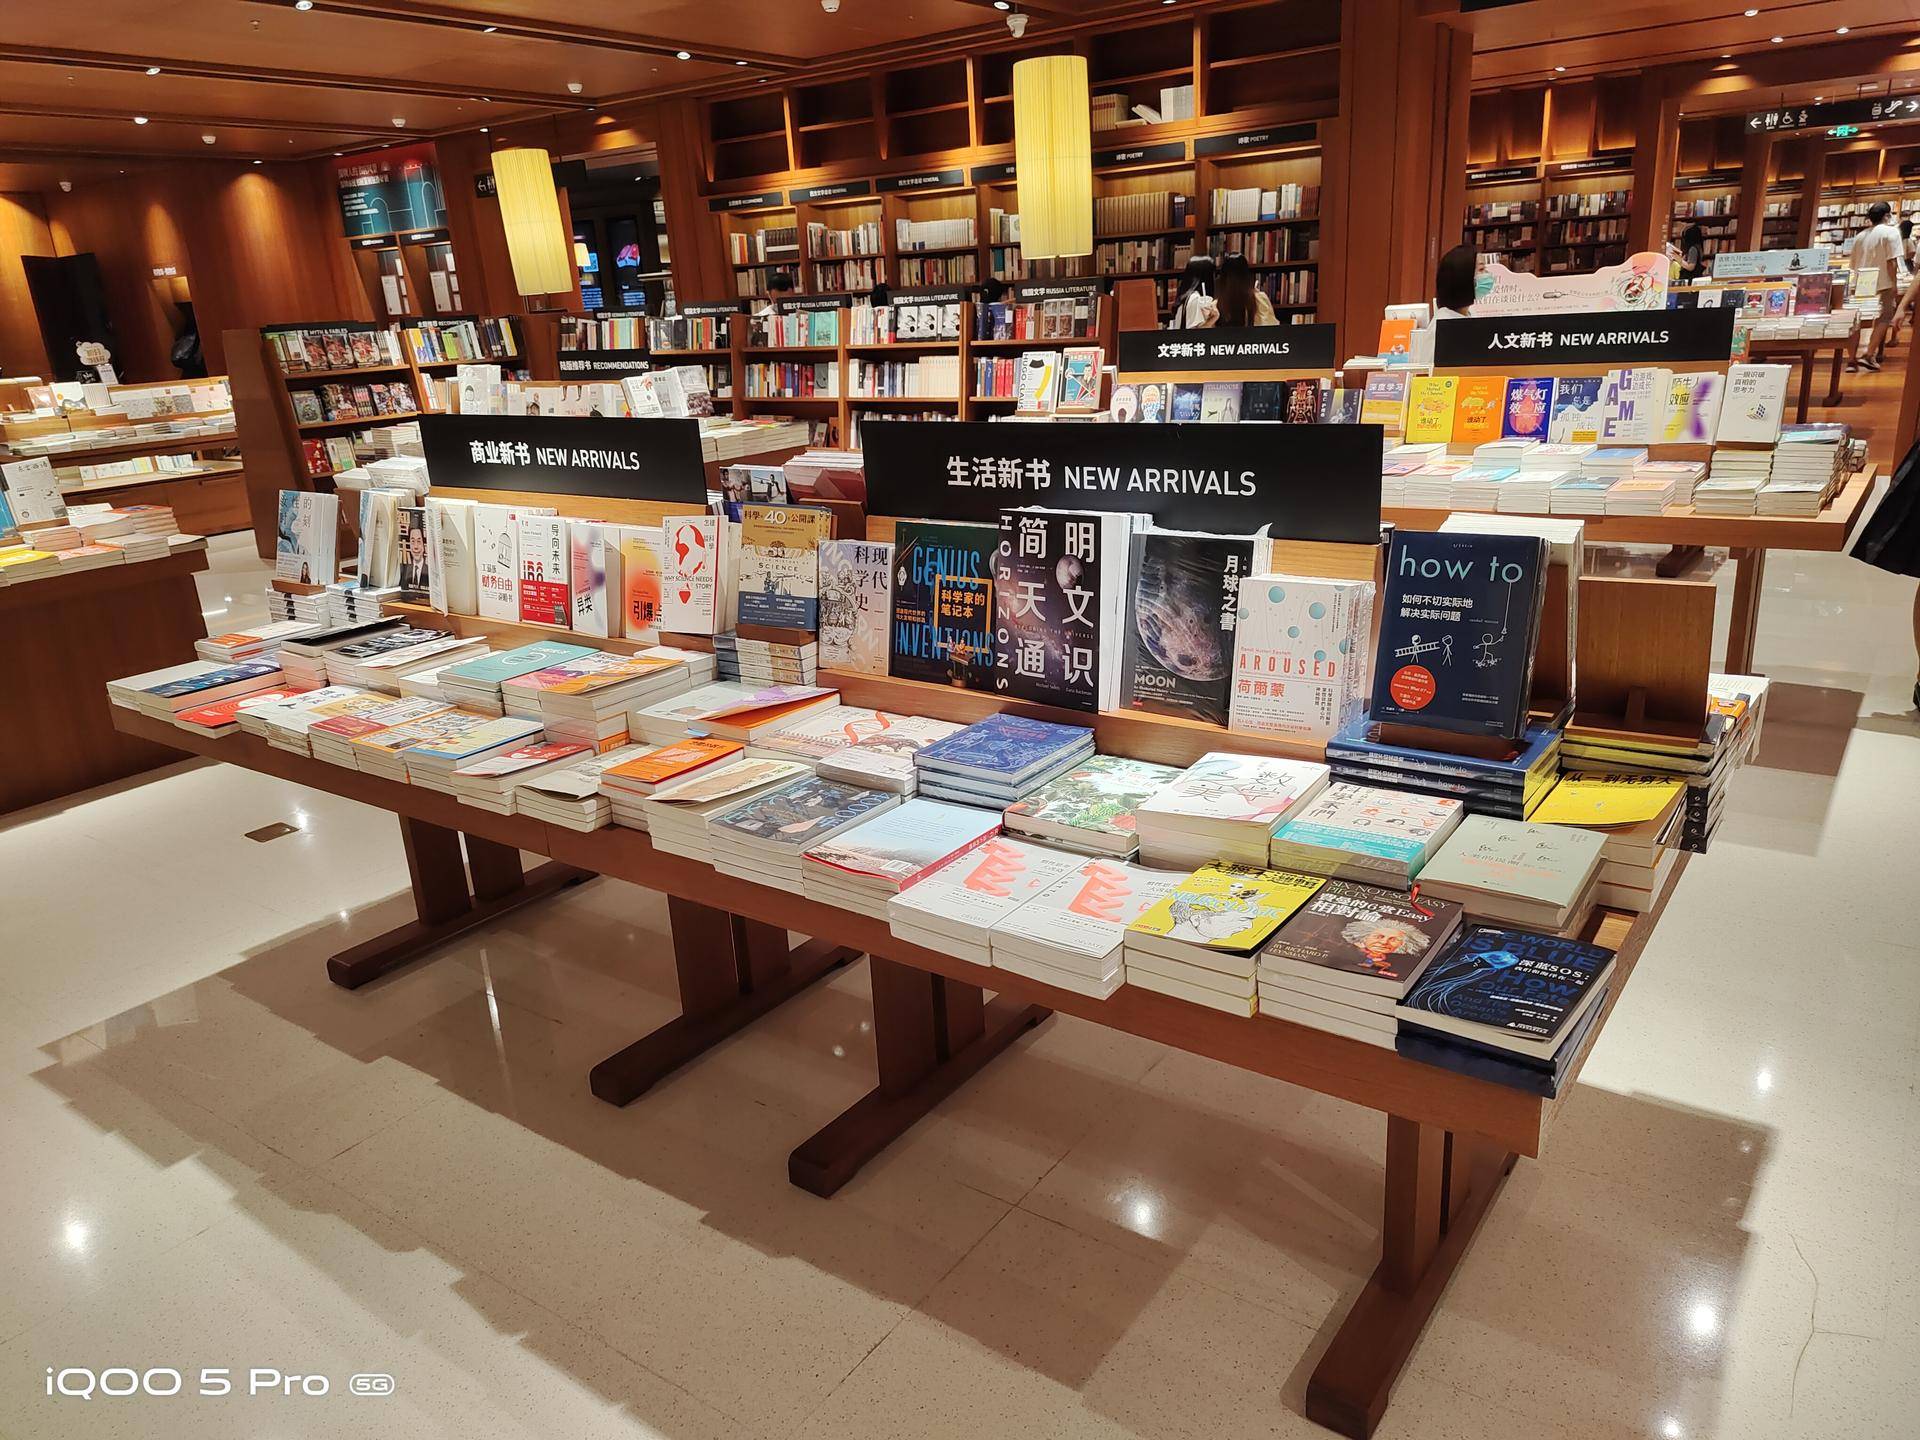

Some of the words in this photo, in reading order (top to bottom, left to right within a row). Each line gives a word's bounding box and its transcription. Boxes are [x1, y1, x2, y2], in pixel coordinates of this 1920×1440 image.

[1250, 134, 1269, 143] POETRY
[1127, 151, 1144, 160] POETRY
[1065, 285, 1096, 293] LITERATURE
[816, 300, 840, 308] LITERATURE
[930, 294, 958, 302] LITERATURE
[1488, 332, 1554, 350] 人文新书
[1560, 333, 1594, 347] NEW
[1596, 330, 1670, 346] ARRIVALS
[1157, 342, 1206, 358] 文学新书
[1210, 344, 1236, 357] NEW
[1237, 342, 1290, 356] ARRIVALS
[592, 361, 649, 370] RECOMMENDATIONS
[1510, 388, 1548, 401] 煤气灯
[1560, 384, 1583, 395] 我们
[469, 440, 531, 466] 商业新书
[536, 448, 568, 467] NEW
[571, 449, 640, 471] ARRIVALS
[946, 455, 1051, 491] 生活新书
[1063, 465, 1117, 491] NEW
[1125, 467, 1257, 497] ARRIVALS
[764, 510, 787, 524] 40
[551, 524, 561, 575] 导向未来
[758, 562, 798, 572] SCIENCE
[872, 548, 888, 591] 现代
[912, 545, 981, 591] GENIUS
[1400, 545, 1474, 581] how
[1489, 556, 1523, 583] to
[482, 574, 512, 591] 财务自由
[854, 545, 870, 612] 科学史
[941, 589, 986, 606] 科学家的
[1220, 555, 1240, 632] 月球之書
[1402, 593, 1474, 609] 如何不切实际地
[940, 603, 974, 618] 笔记本
[995, 516, 1014, 690] HORIZONS
[1400, 608, 1462, 622] 解决实际问题
[895, 621, 994, 668] INVENTIONS
[1240, 654, 1336, 678] AROUSED
[1134, 673, 1176, 688] MOON
[1238, 678, 1286, 698] 荷爾蒙
[1566, 772, 1676, 785] 从一到无穷大
[1326, 886, 1369, 900] PIECES
[1331, 880, 1351, 890] SIX
[1310, 902, 1383, 923] 相對論
[1396, 908, 1435, 923] Easy
[1285, 944, 1318, 958] RICHARD
[1521, 935, 1606, 959] WORLD
